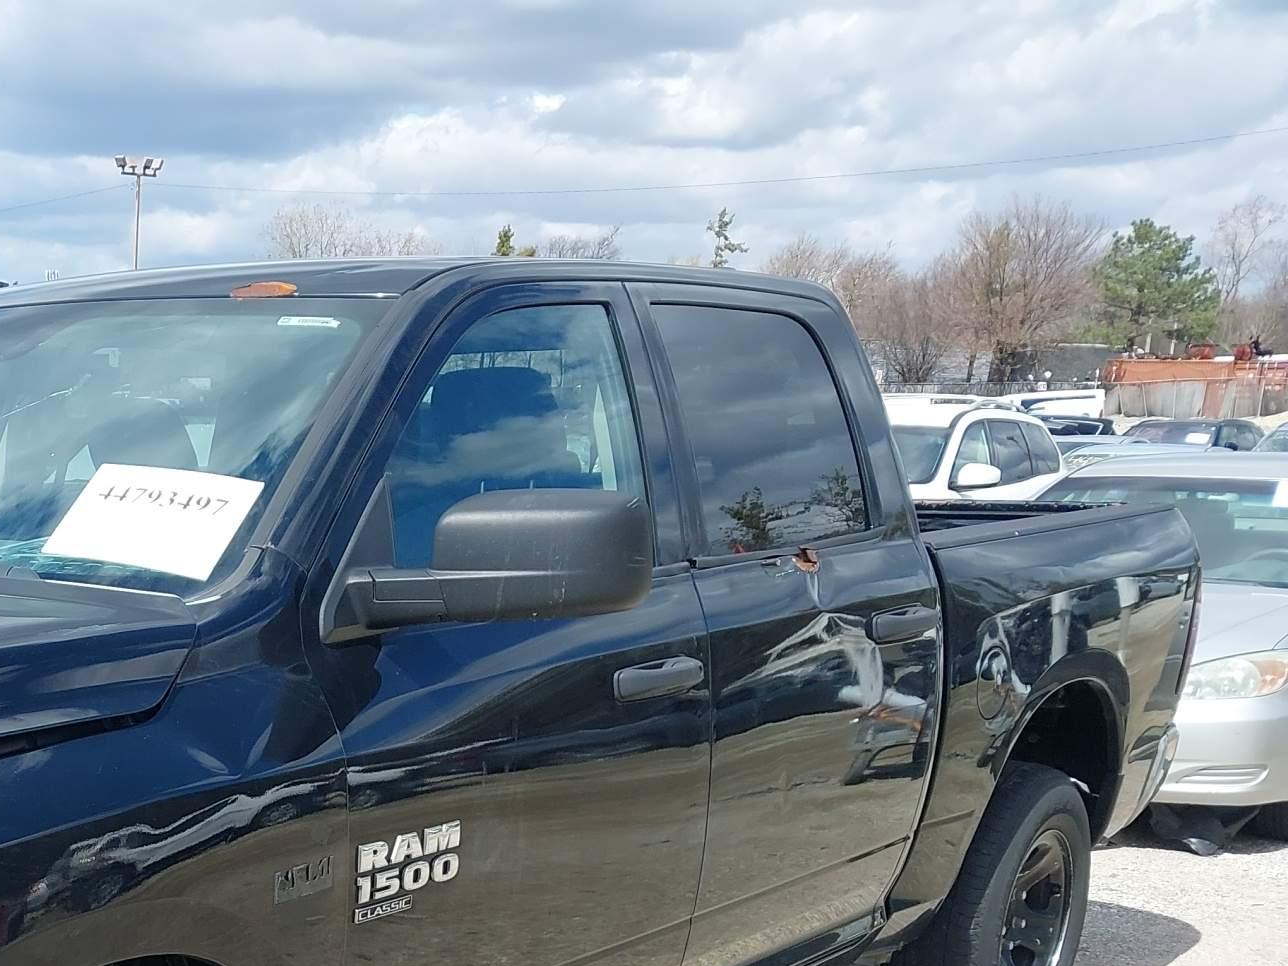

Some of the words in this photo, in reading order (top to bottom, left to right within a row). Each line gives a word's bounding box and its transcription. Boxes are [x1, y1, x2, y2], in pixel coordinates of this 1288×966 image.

[98, 486, 229, 515] 44793497
[357, 819, 460, 873] RAM
[356, 852, 460, 904] 1500
[357, 898, 411, 922] CLASSIC
